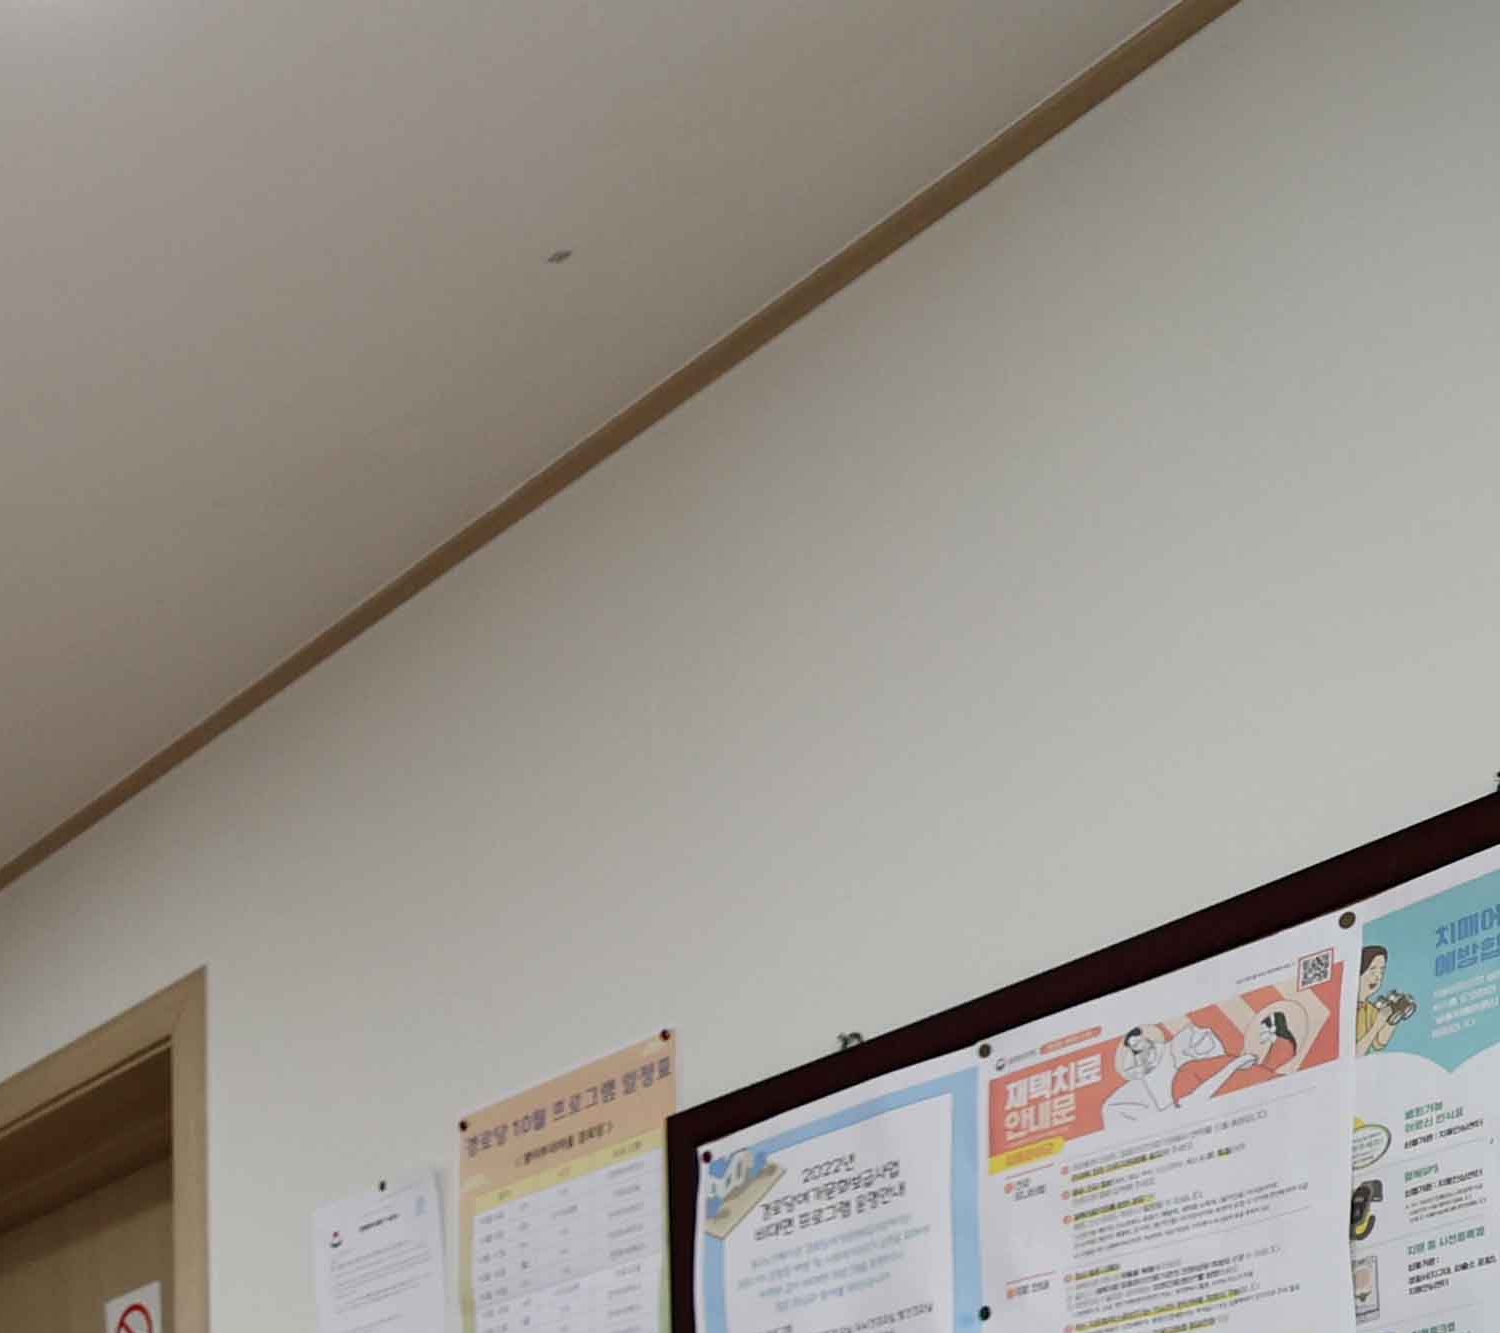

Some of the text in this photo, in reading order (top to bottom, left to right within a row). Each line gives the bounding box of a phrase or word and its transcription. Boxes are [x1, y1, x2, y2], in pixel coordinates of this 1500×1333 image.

[1005, 1054, 1102, 1110] 재택치료
[1004, 1093, 1077, 1141] 안내문
[801, 1152, 855, 1184] 2022년
[754, 1181, 907, 1242] 비대면 프로그램 운영안내
